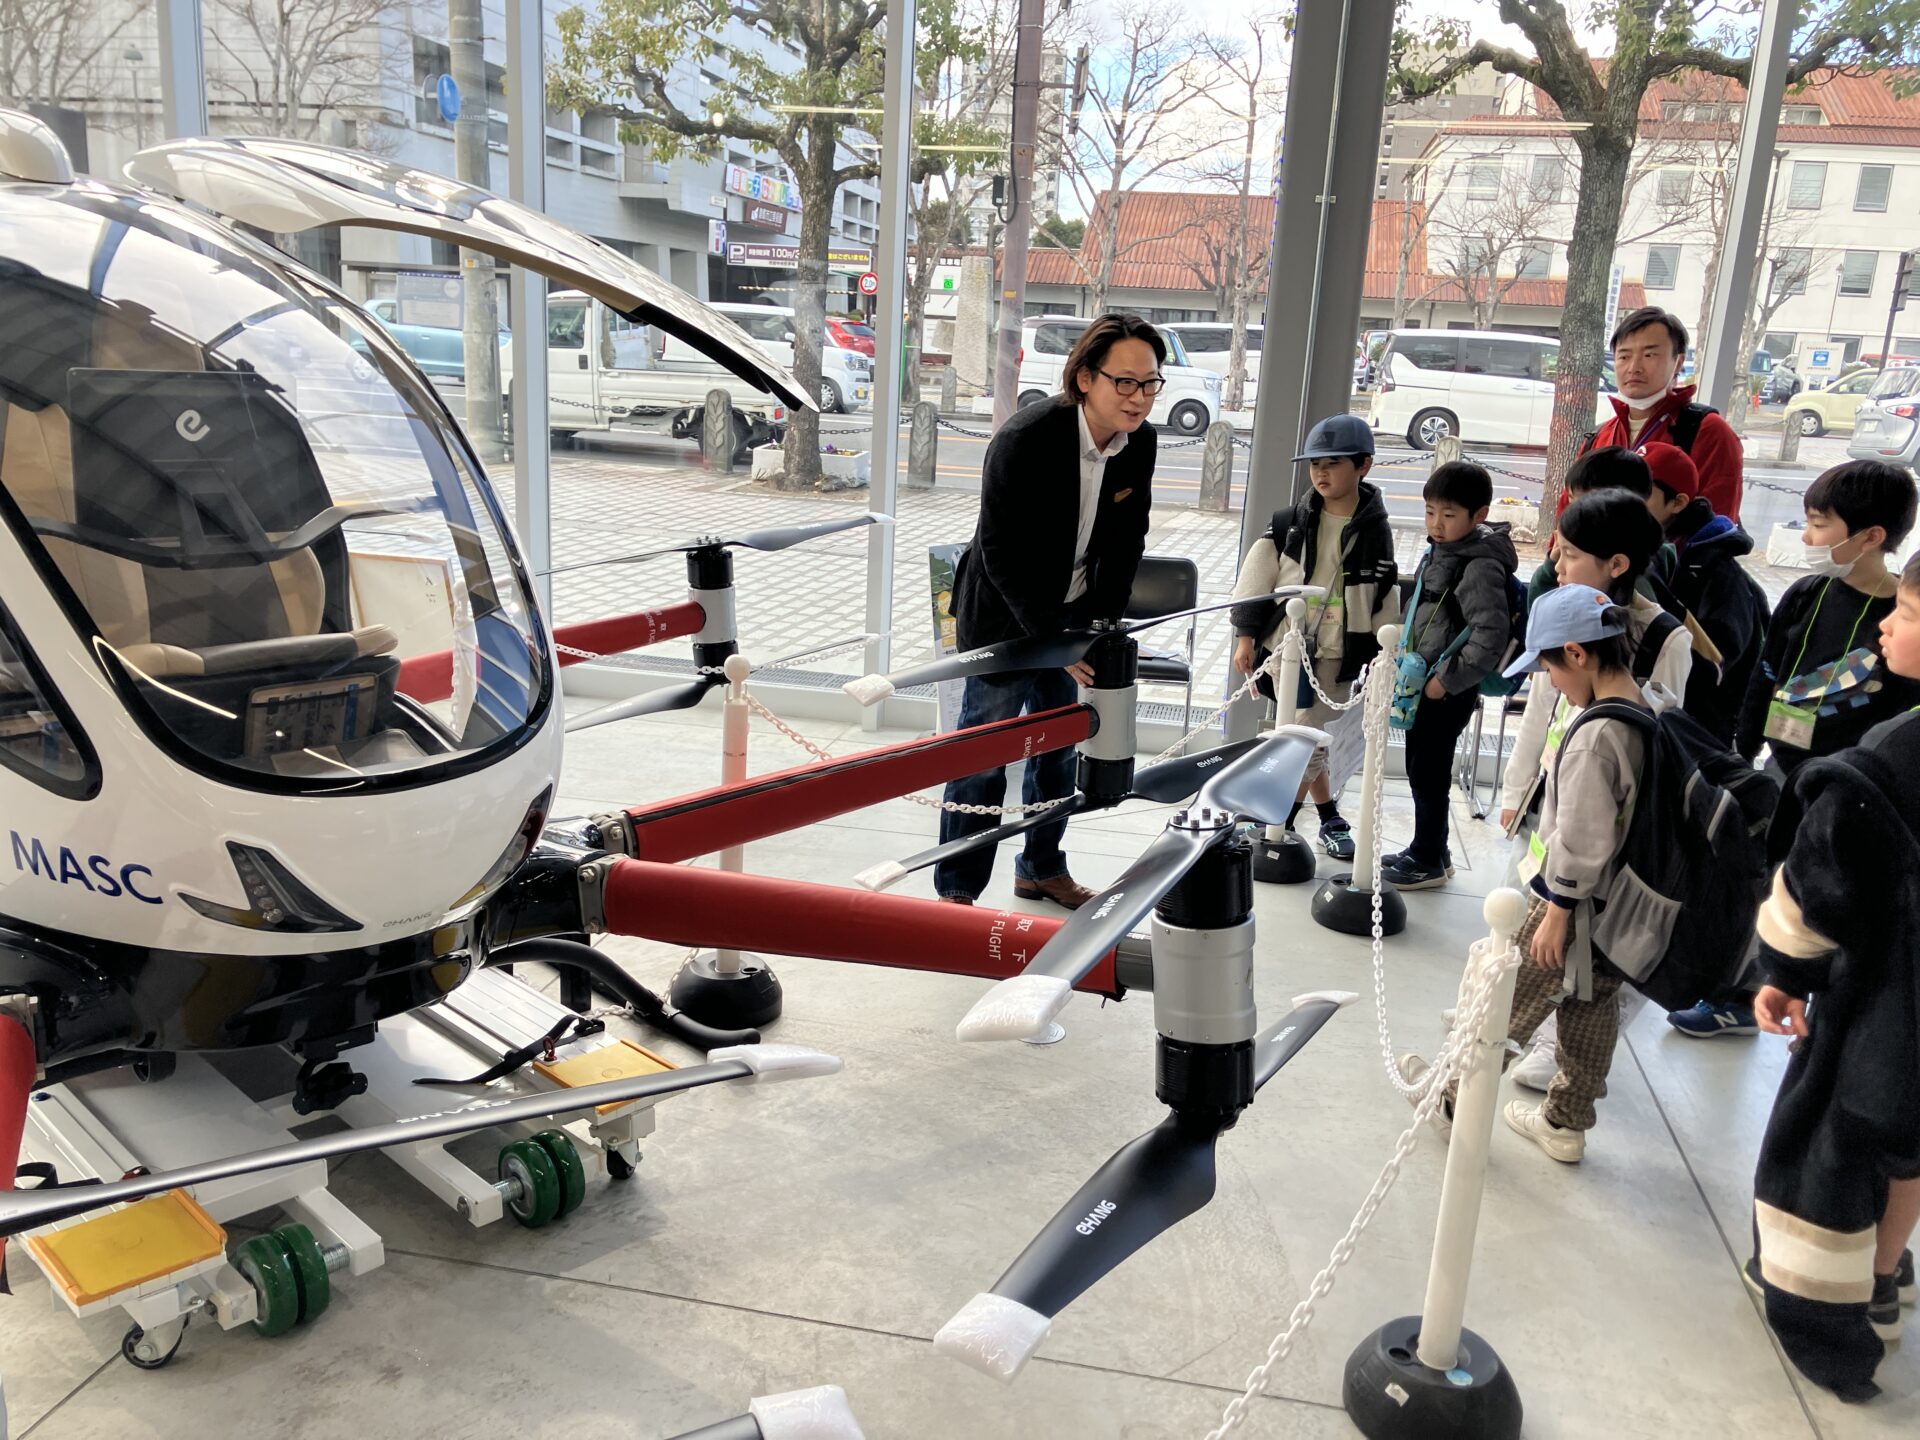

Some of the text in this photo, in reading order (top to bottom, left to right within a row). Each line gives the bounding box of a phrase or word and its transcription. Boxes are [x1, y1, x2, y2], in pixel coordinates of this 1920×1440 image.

[730, 244, 745, 260] P
[9, 829, 164, 905] MASC
[988, 919, 1007, 961] FLIGHT
